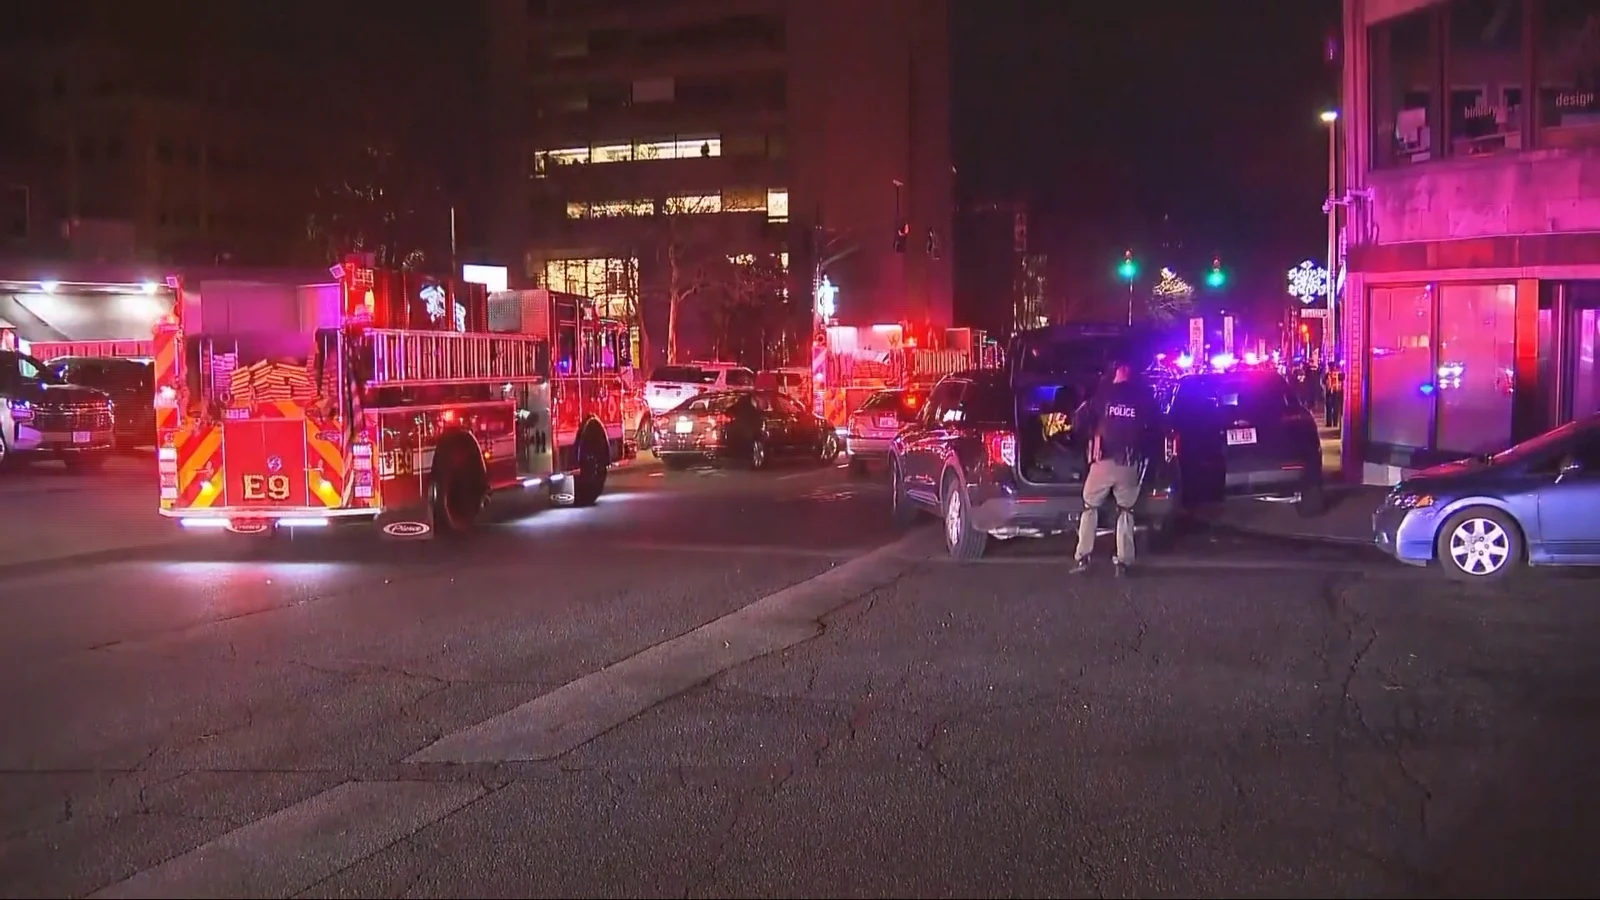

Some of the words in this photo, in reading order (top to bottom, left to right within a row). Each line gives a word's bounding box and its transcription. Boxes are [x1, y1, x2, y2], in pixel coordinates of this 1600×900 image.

[1555, 91, 1594, 107] design
[1109, 406, 1136, 418] POLICE
[394, 447, 413, 475] E9
[243, 474, 290, 500] E9
